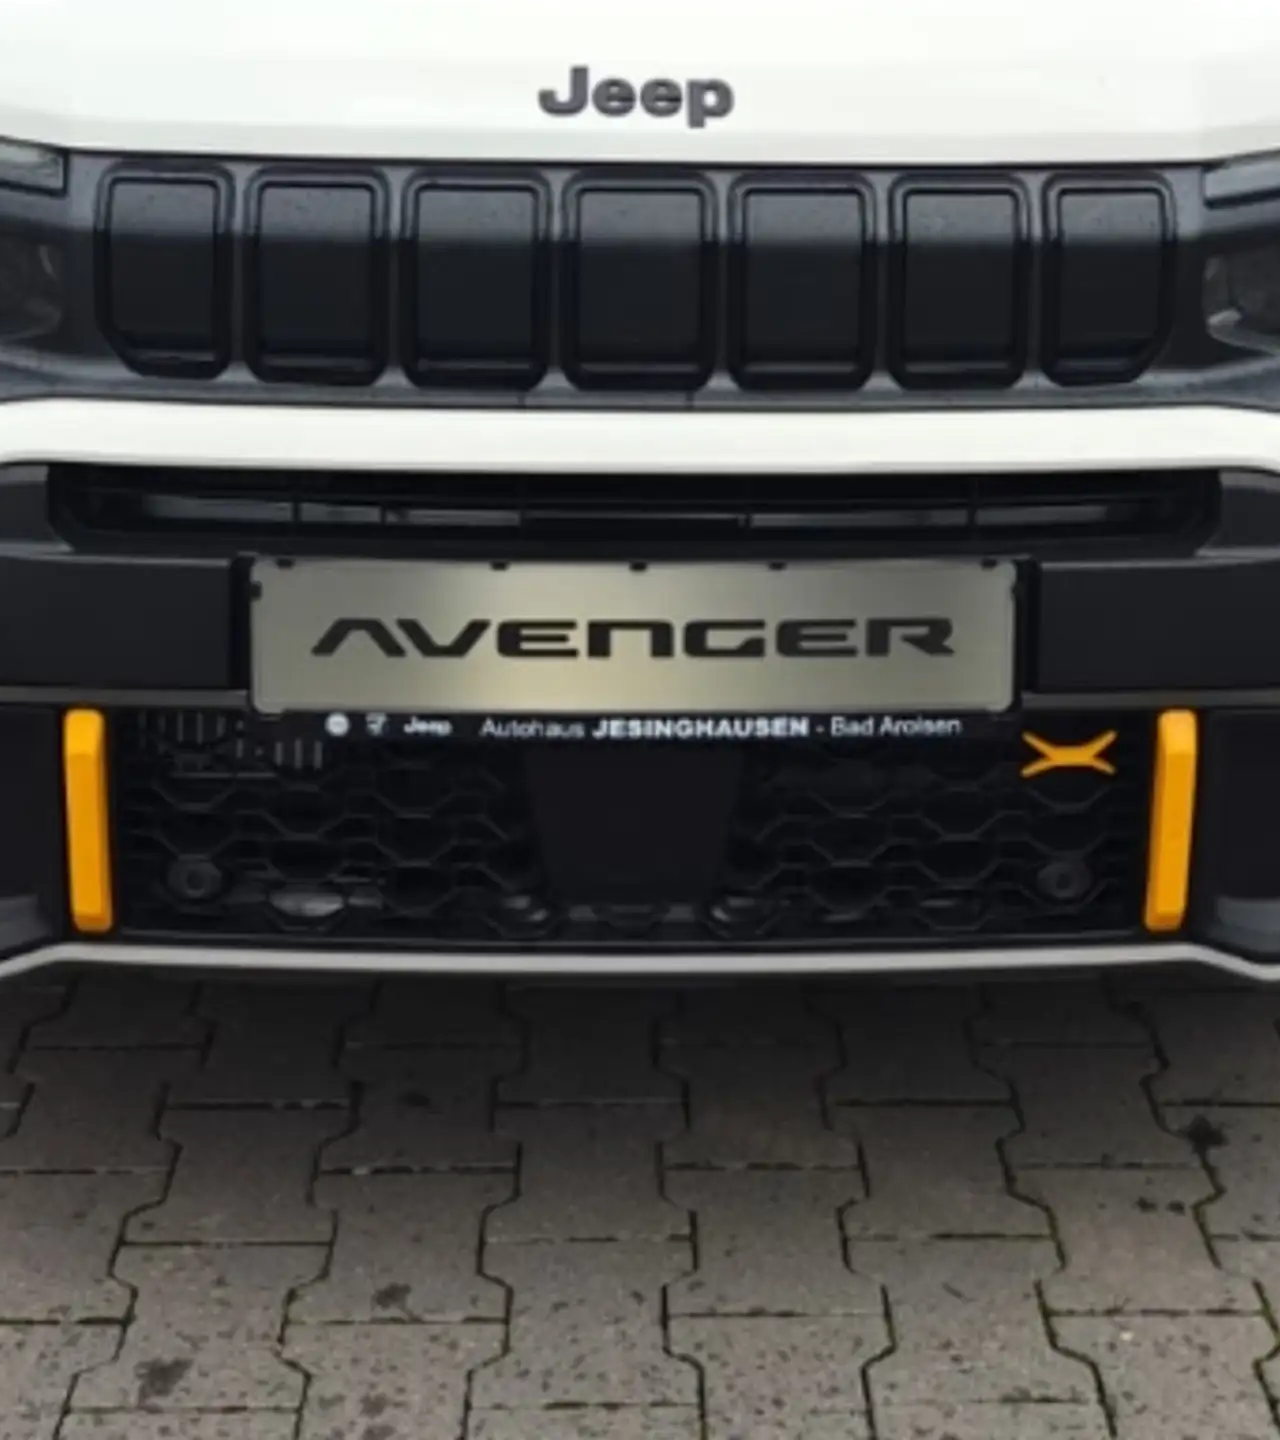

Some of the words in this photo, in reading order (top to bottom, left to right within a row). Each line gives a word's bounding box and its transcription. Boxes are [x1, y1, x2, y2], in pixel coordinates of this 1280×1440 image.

[538, 66, 735, 130] Jeep
[310, 617, 955, 659] AVENGER
[479, 717, 585, 739] Autohaus
[591, 716, 810, 739] JESINGHAUSEN
[830, 716, 874, 737] Bad
[879, 716, 962, 737] Arolsen
